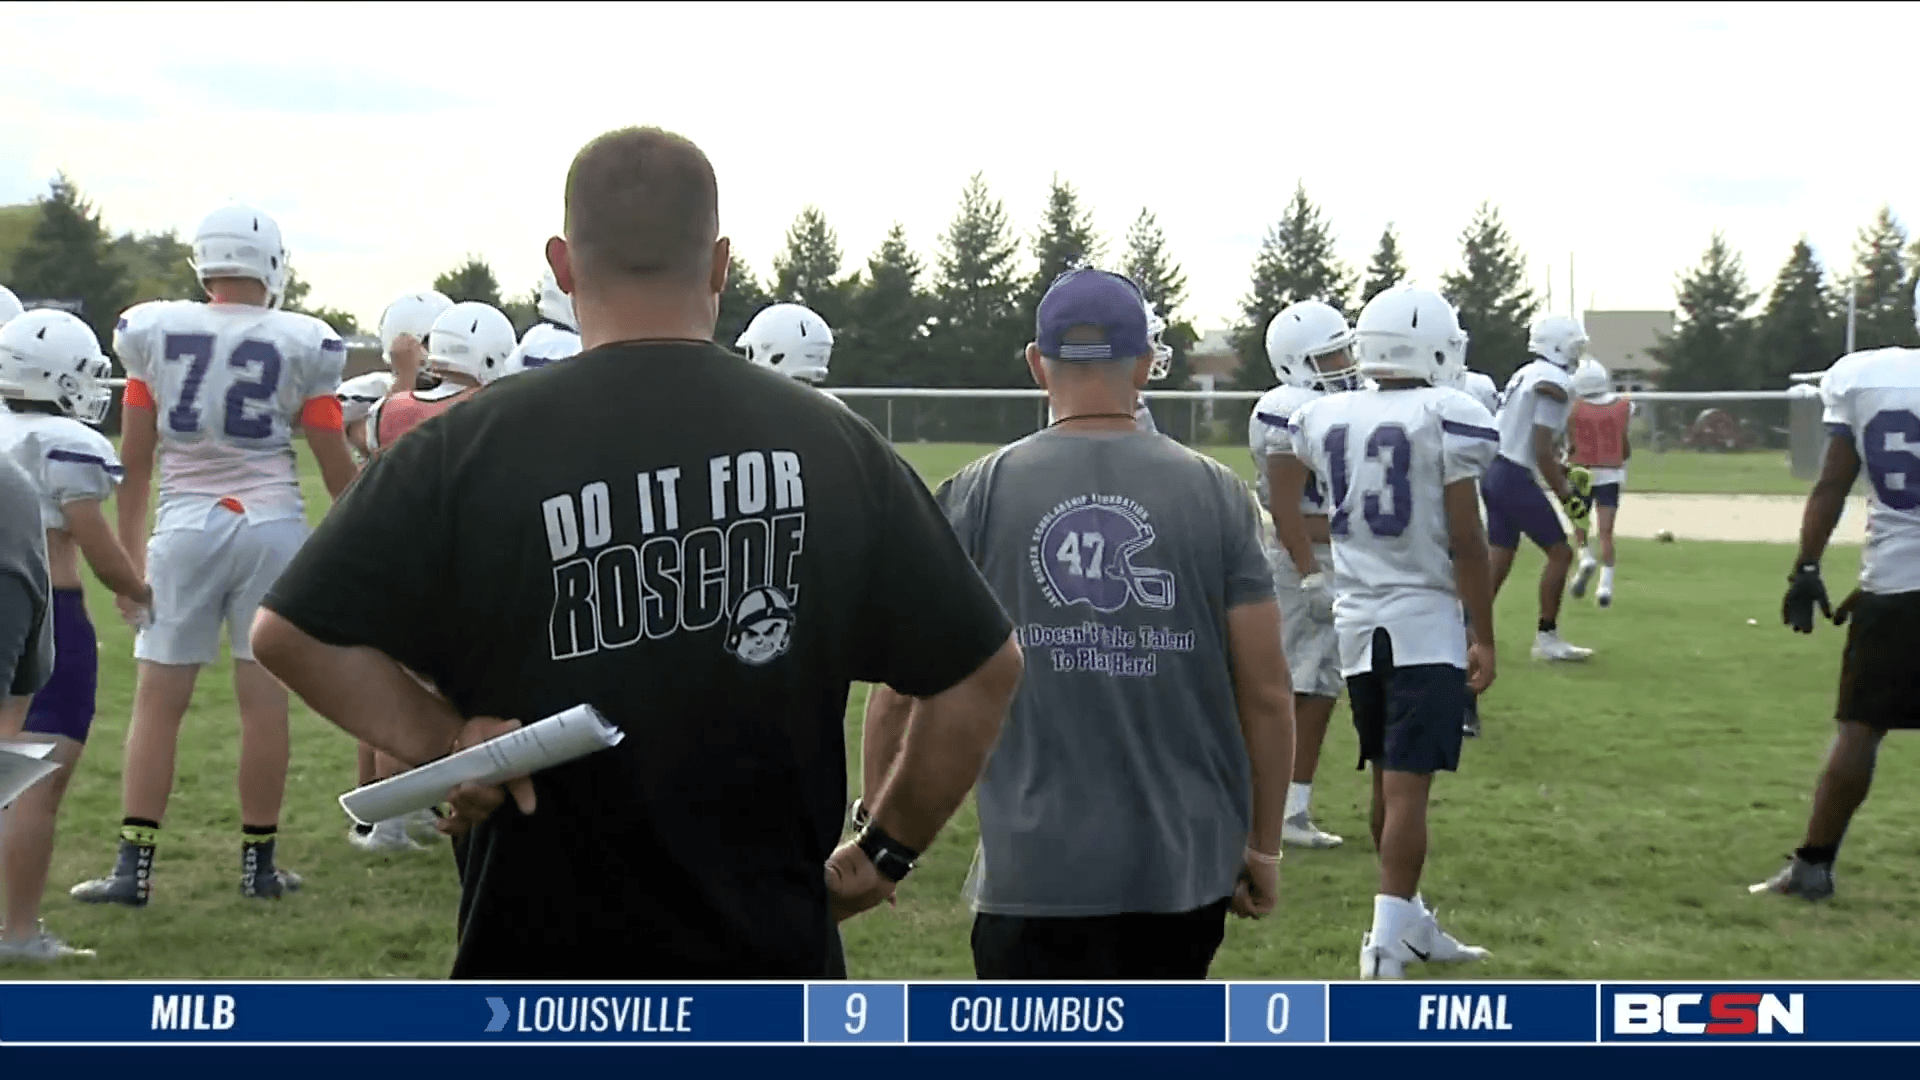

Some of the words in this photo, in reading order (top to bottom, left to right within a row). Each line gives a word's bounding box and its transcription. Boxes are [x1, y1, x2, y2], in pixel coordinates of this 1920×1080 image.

[165, 333, 281, 440] 72
[542, 481, 612, 561] DO
[637, 467, 680, 534] IT
[710, 451, 804, 520] FOR
[1323, 423, 1412, 537] 13
[550, 512, 805, 660] ROSCOE
[1056, 531, 1105, 579] 47
[1028, 621, 1099, 646] Doesn't
[1139, 626, 1195, 651] Talent
[1052, 648, 1075, 673] To
[1112, 651, 1157, 676] Hard
